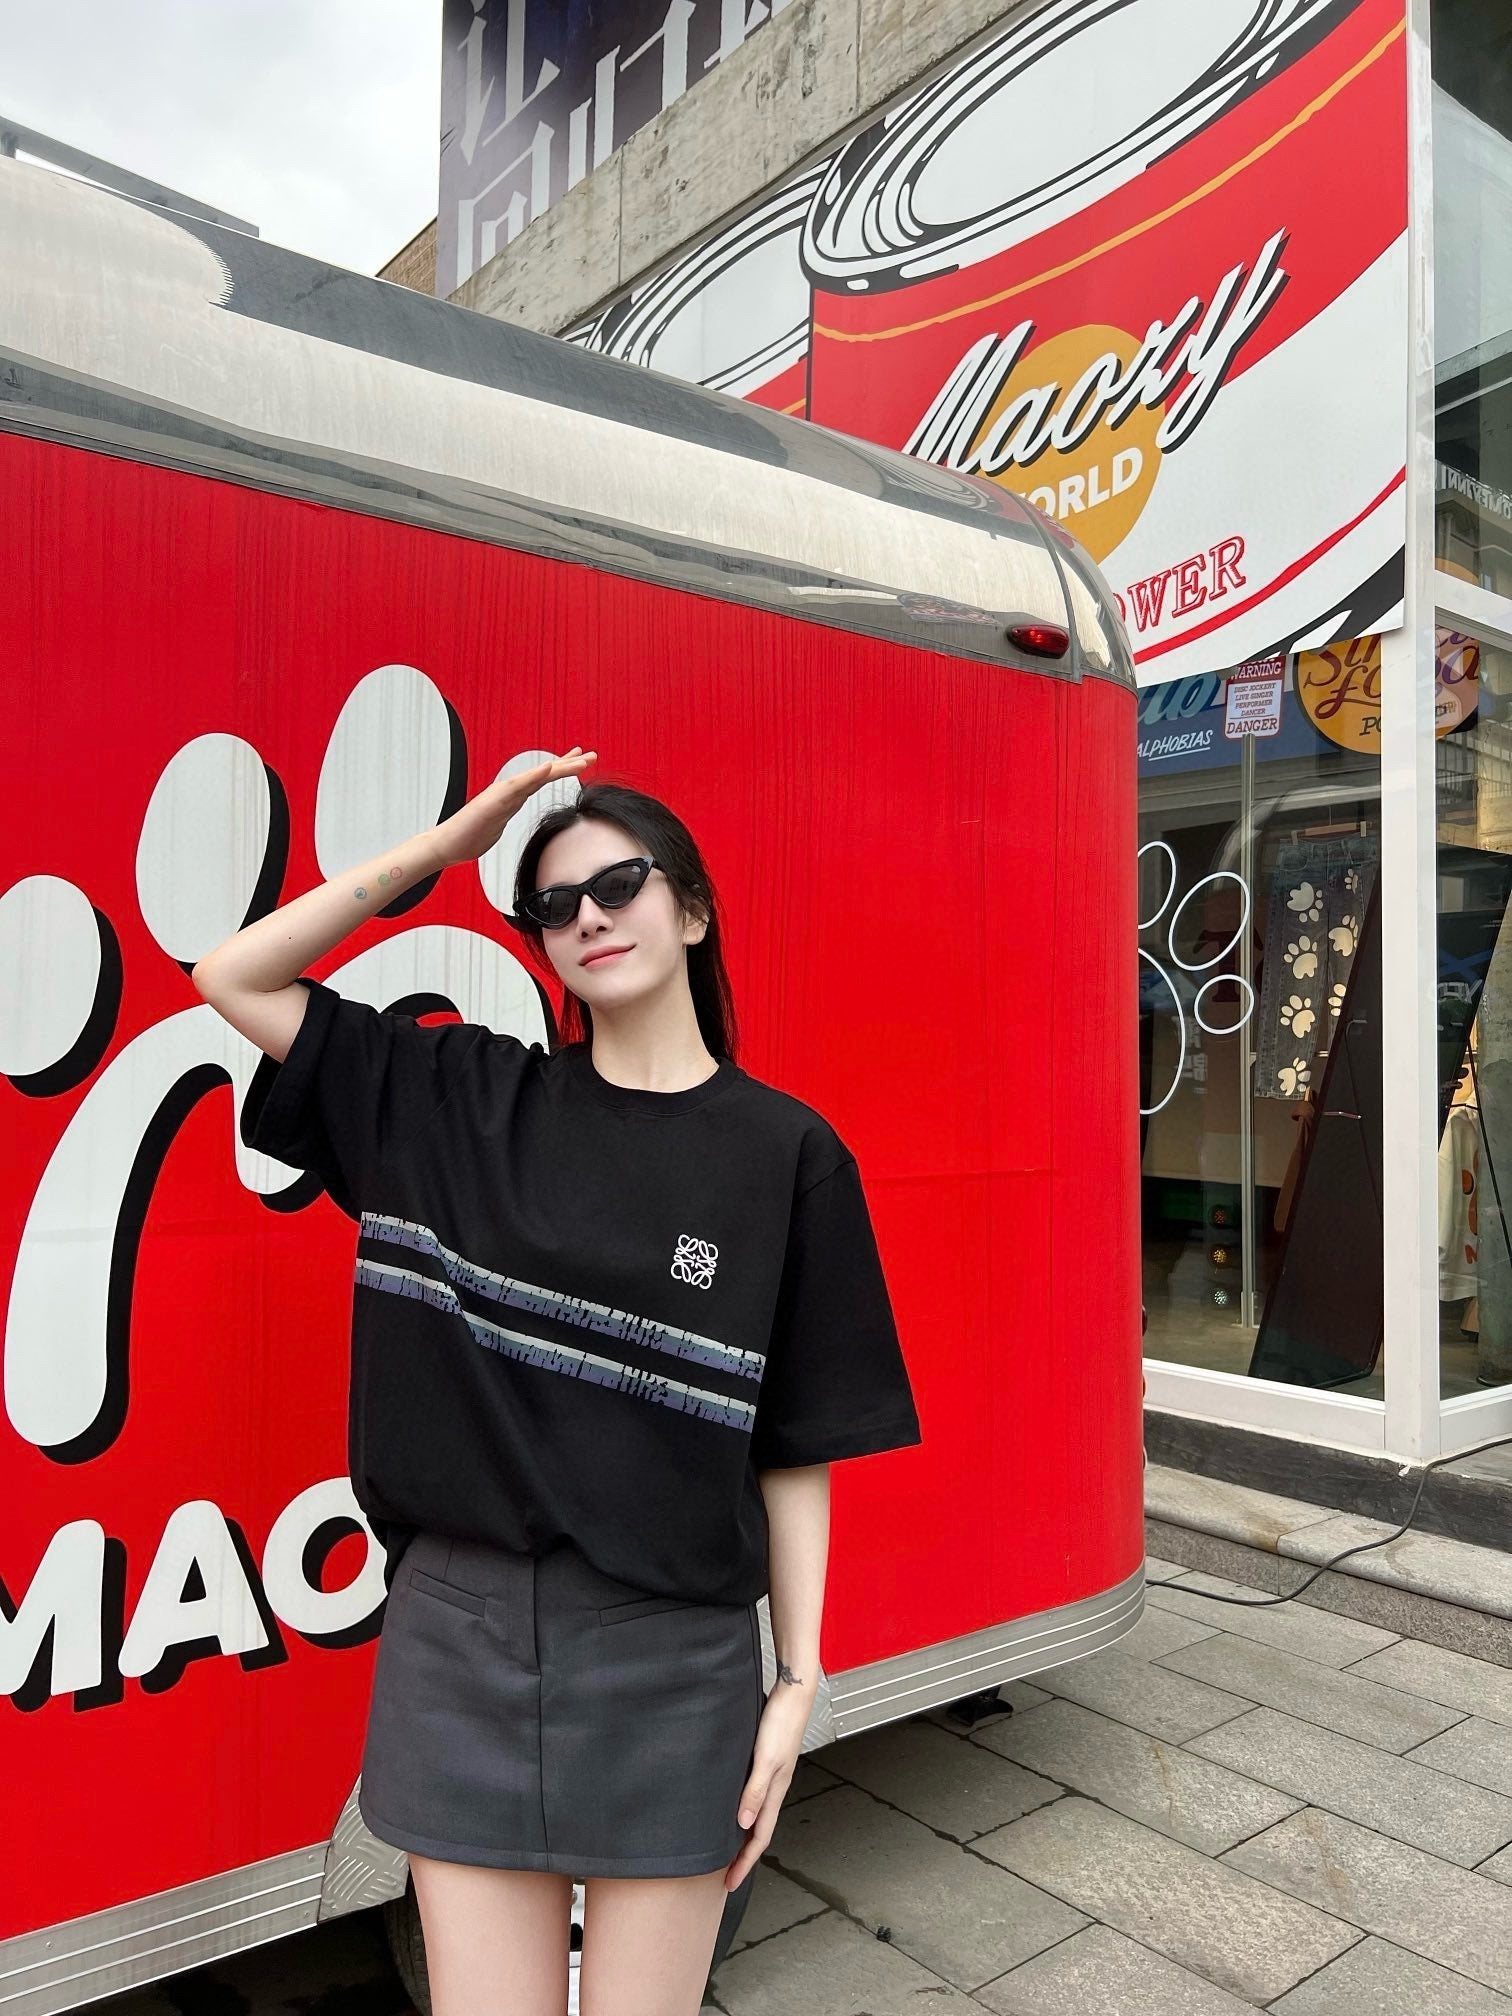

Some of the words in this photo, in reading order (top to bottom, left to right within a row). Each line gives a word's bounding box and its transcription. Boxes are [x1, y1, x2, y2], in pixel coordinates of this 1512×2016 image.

[1019, 447, 1143, 520] ORLD
[1112, 535, 1247, 633] WER
[1250, 691, 1273, 699] SINGER
[1226, 718, 1278, 734] DANGER
